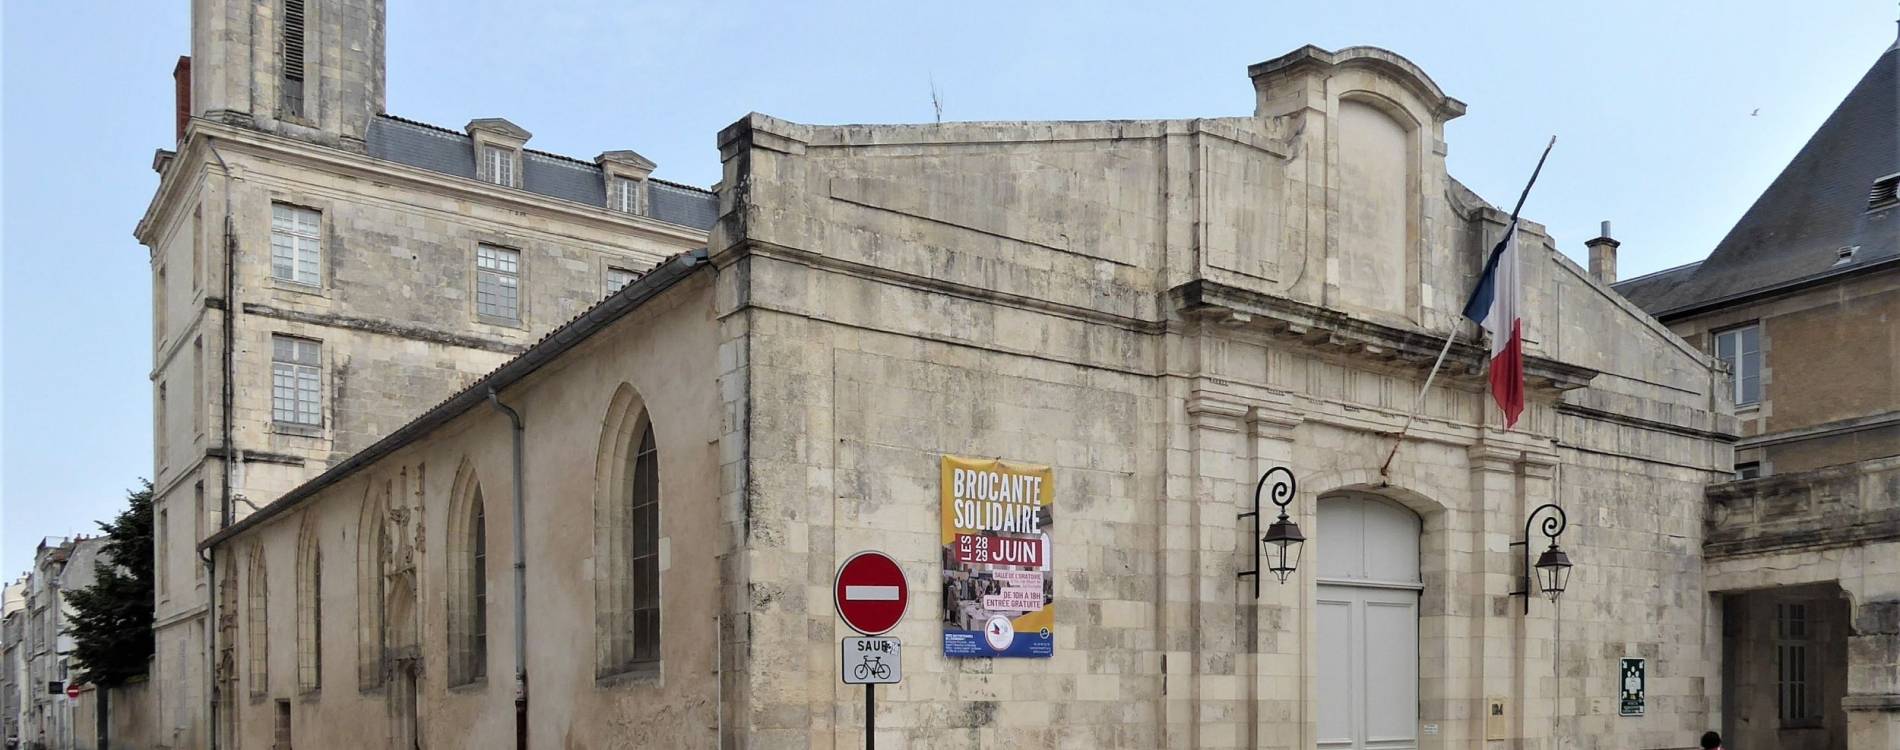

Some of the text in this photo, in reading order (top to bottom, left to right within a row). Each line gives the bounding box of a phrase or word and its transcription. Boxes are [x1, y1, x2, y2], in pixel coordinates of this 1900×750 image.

[954, 468, 1041, 505] BROCANTE
[954, 499, 1041, 534] SOLIDAIRE
[961, 536, 971, 560] LES
[975, 537, 988, 549] 28
[975, 549, 988, 562] 29
[992, 540, 1035, 562] JUIN
[1003, 591, 1012, 599] DE
[1013, 591, 1023, 599] 10H
[1030, 592, 1041, 600] 18H
[1010, 600, 1041, 608] GRATUITE
[857, 640, 888, 652] SAUF
